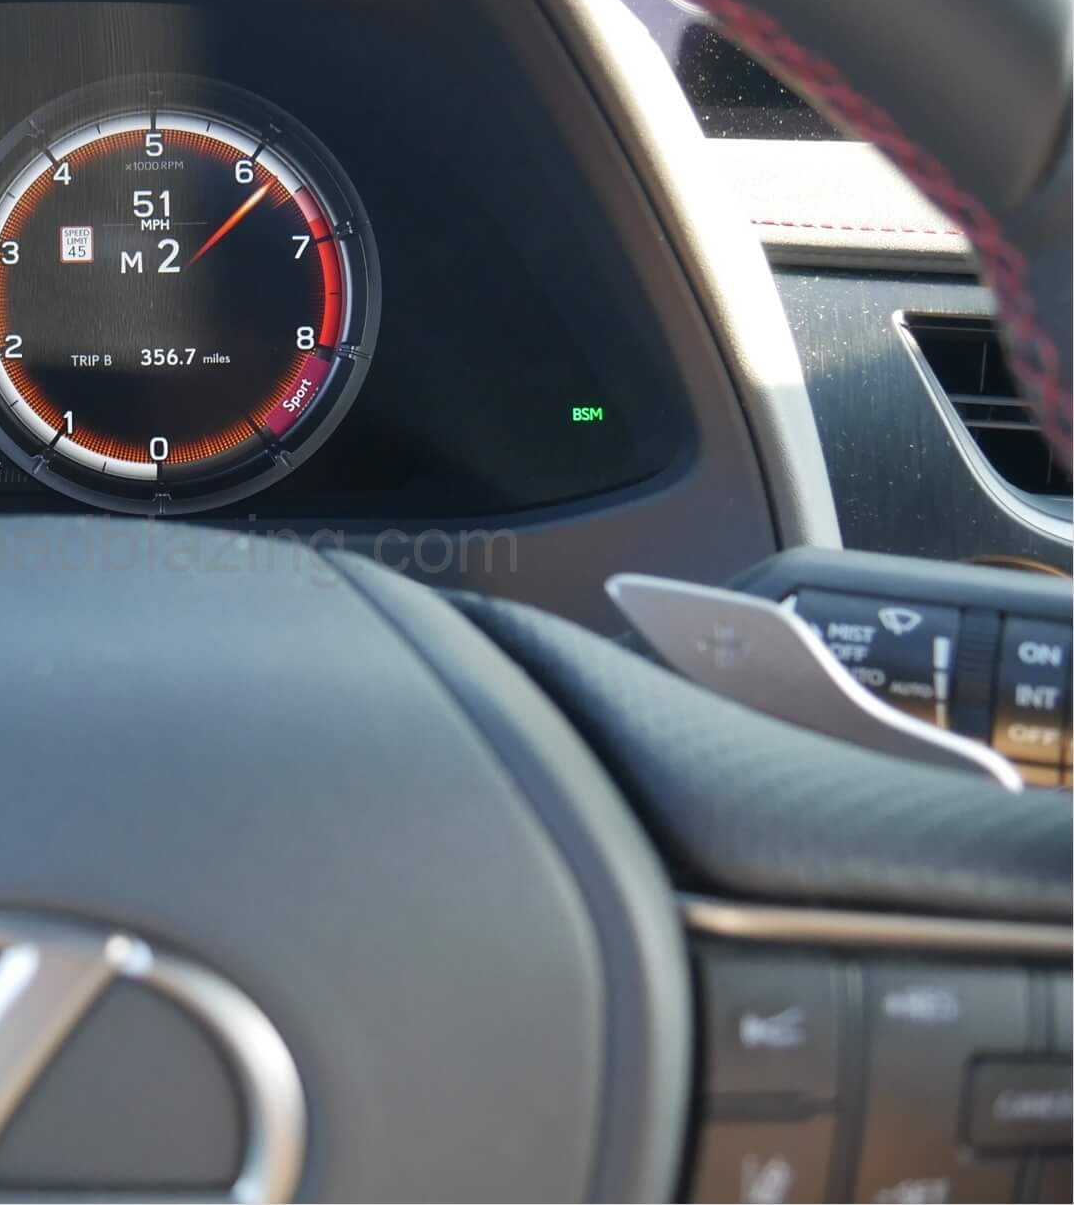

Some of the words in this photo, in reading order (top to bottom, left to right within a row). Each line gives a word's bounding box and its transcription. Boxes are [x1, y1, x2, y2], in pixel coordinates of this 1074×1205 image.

[145, 134, 163, 157] 5
[53, 161, 72, 185] 4
[235, 160, 254, 184] 6
[133, 190, 171, 218] 51
[64, 228, 90, 237] SPEED
[140, 218, 170, 231] MPH
[1, 240, 20, 265] 3
[66, 237, 88, 246] LIMIT
[68, 245, 87, 258] 45
[291, 235, 310, 259] 7
[120, 251, 143, 274] M
[157, 238, 181, 273] 2
[4, 334, 24, 359] 2
[296, 326, 315, 350] 8
[71, 354, 100, 367] TRIP
[104, 354, 113, 367] B
[140, 348, 196, 366] 356.7
[202, 352, 231, 364] miles
[282, 378, 313, 412] Sport
[63, 410, 74, 434] 1
[572, 406, 603, 422] BSM
[149, 437, 169, 461] 0
[828, 622, 877, 643] MIST
[1017, 641, 1062, 667] ON
[1015, 683, 1060, 710] INT
[1007, 723, 1060, 746] OFF
